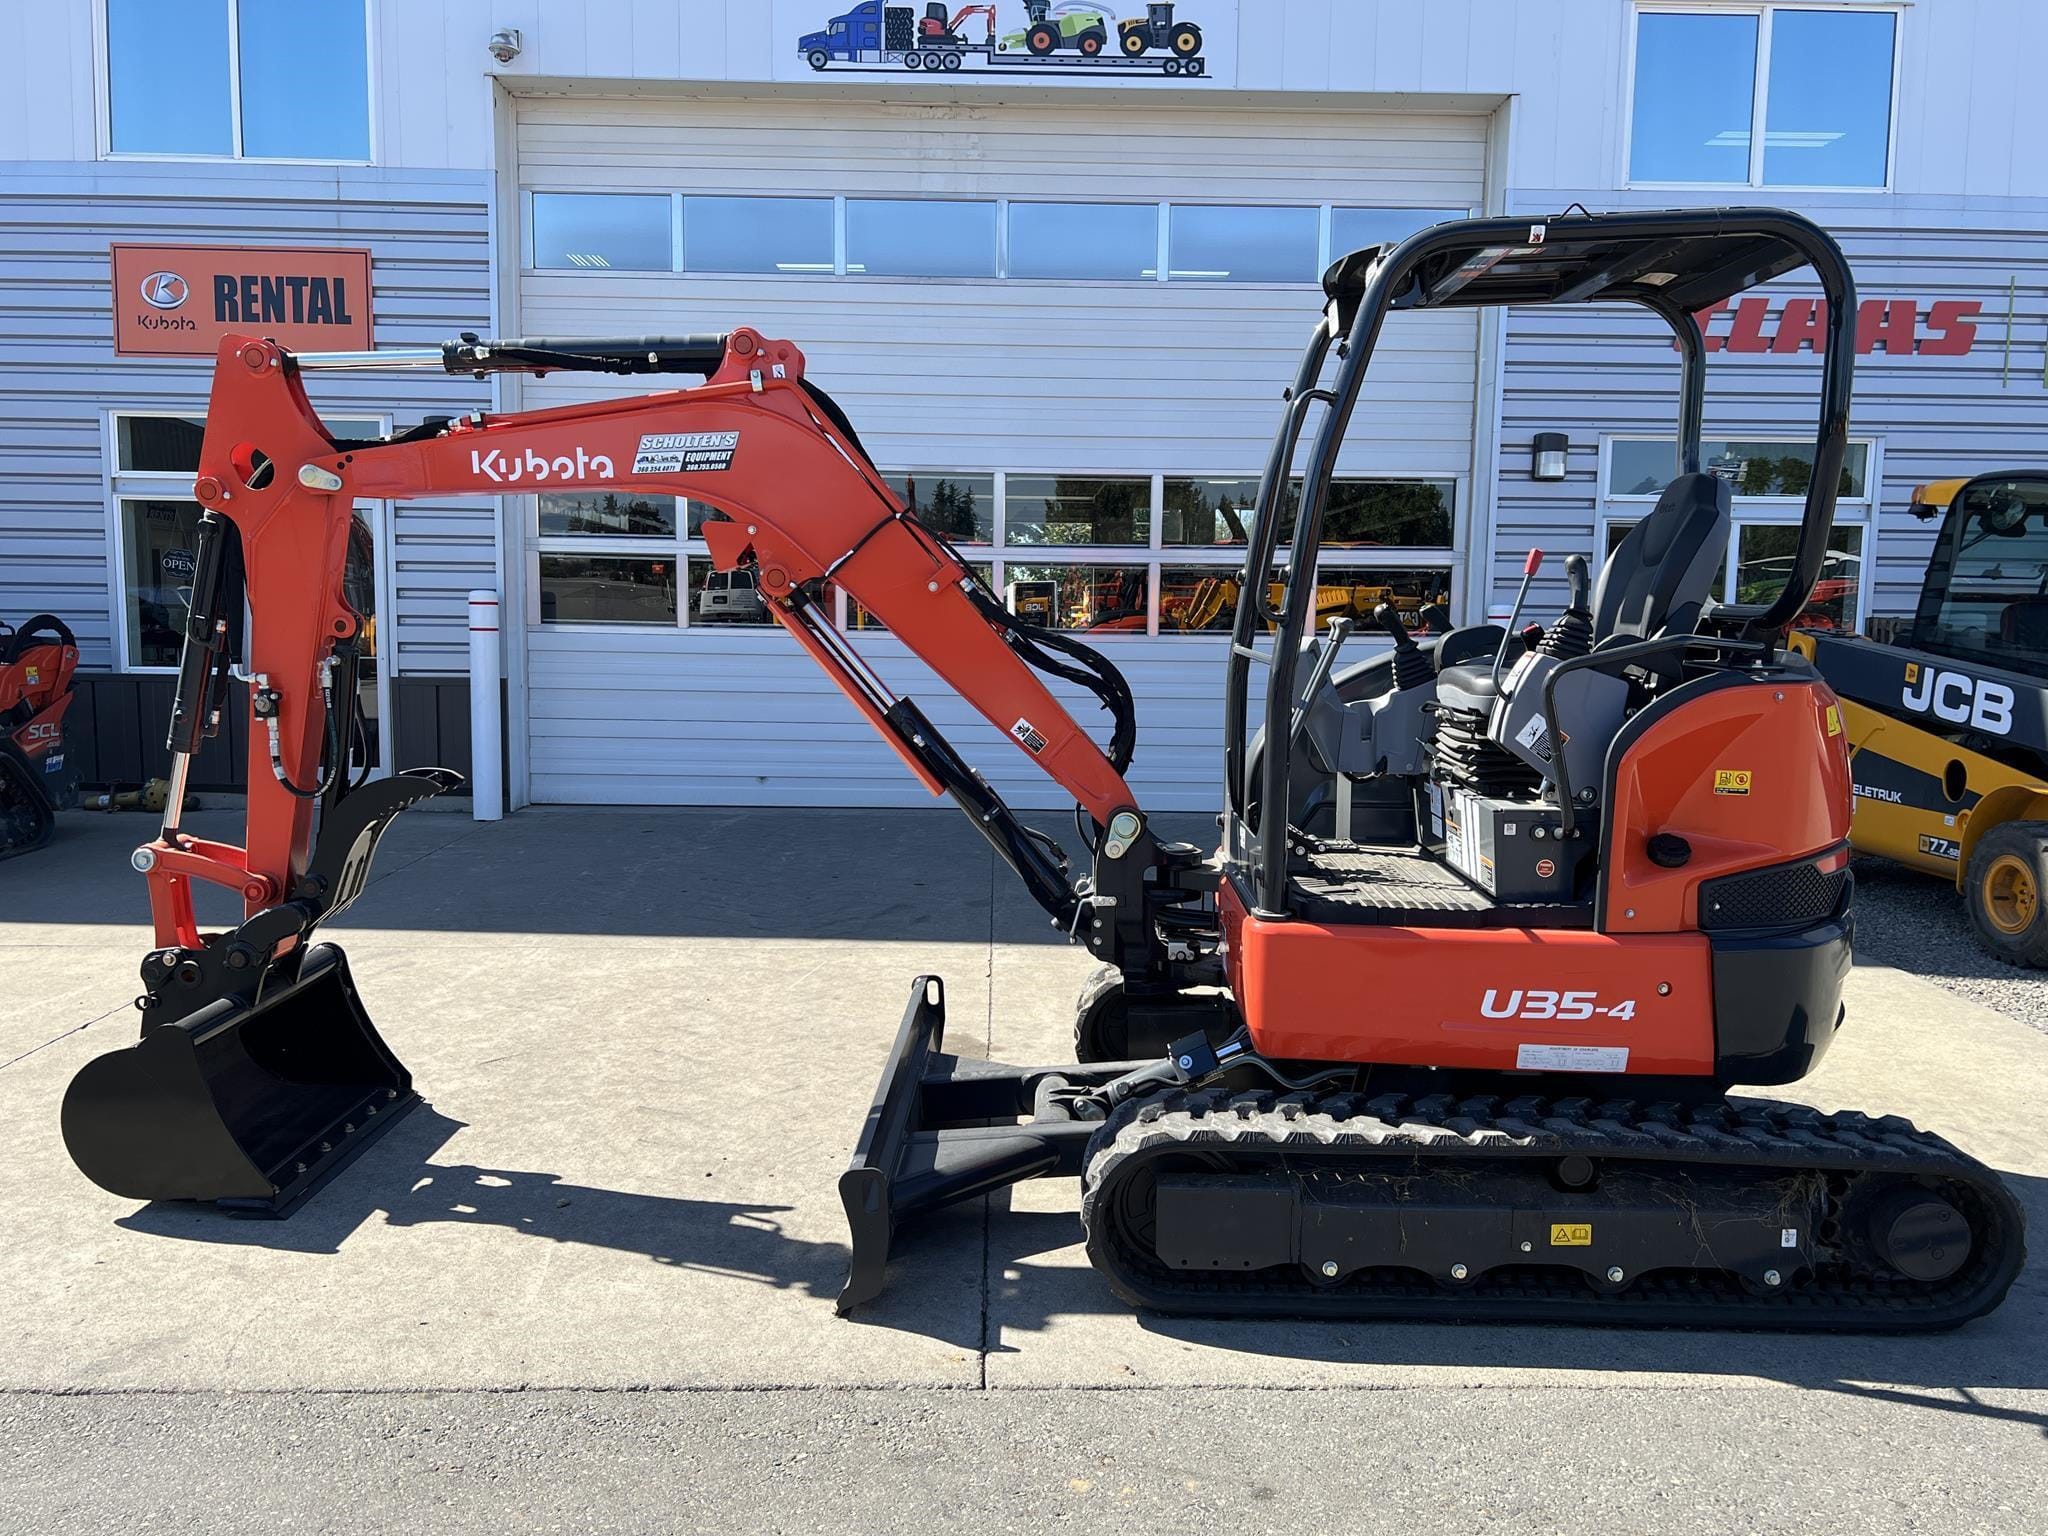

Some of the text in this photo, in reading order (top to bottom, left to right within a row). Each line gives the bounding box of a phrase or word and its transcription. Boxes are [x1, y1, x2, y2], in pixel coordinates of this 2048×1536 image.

[213, 274, 352, 325] RENTAL
[138, 315, 196, 331] Kubota
[641, 433, 737, 450] SCHOLTEN'S
[471, 446, 615, 482] Kubota
[685, 450, 733, 463] EQUIPMENT
[162, 558, 196, 571] OPEN
[1902, 667, 2015, 735] JCB
[27, 722, 60, 740] SCL
[1852, 783, 1902, 803] ELETRUK
[1480, 989, 1636, 1021] U35-4
